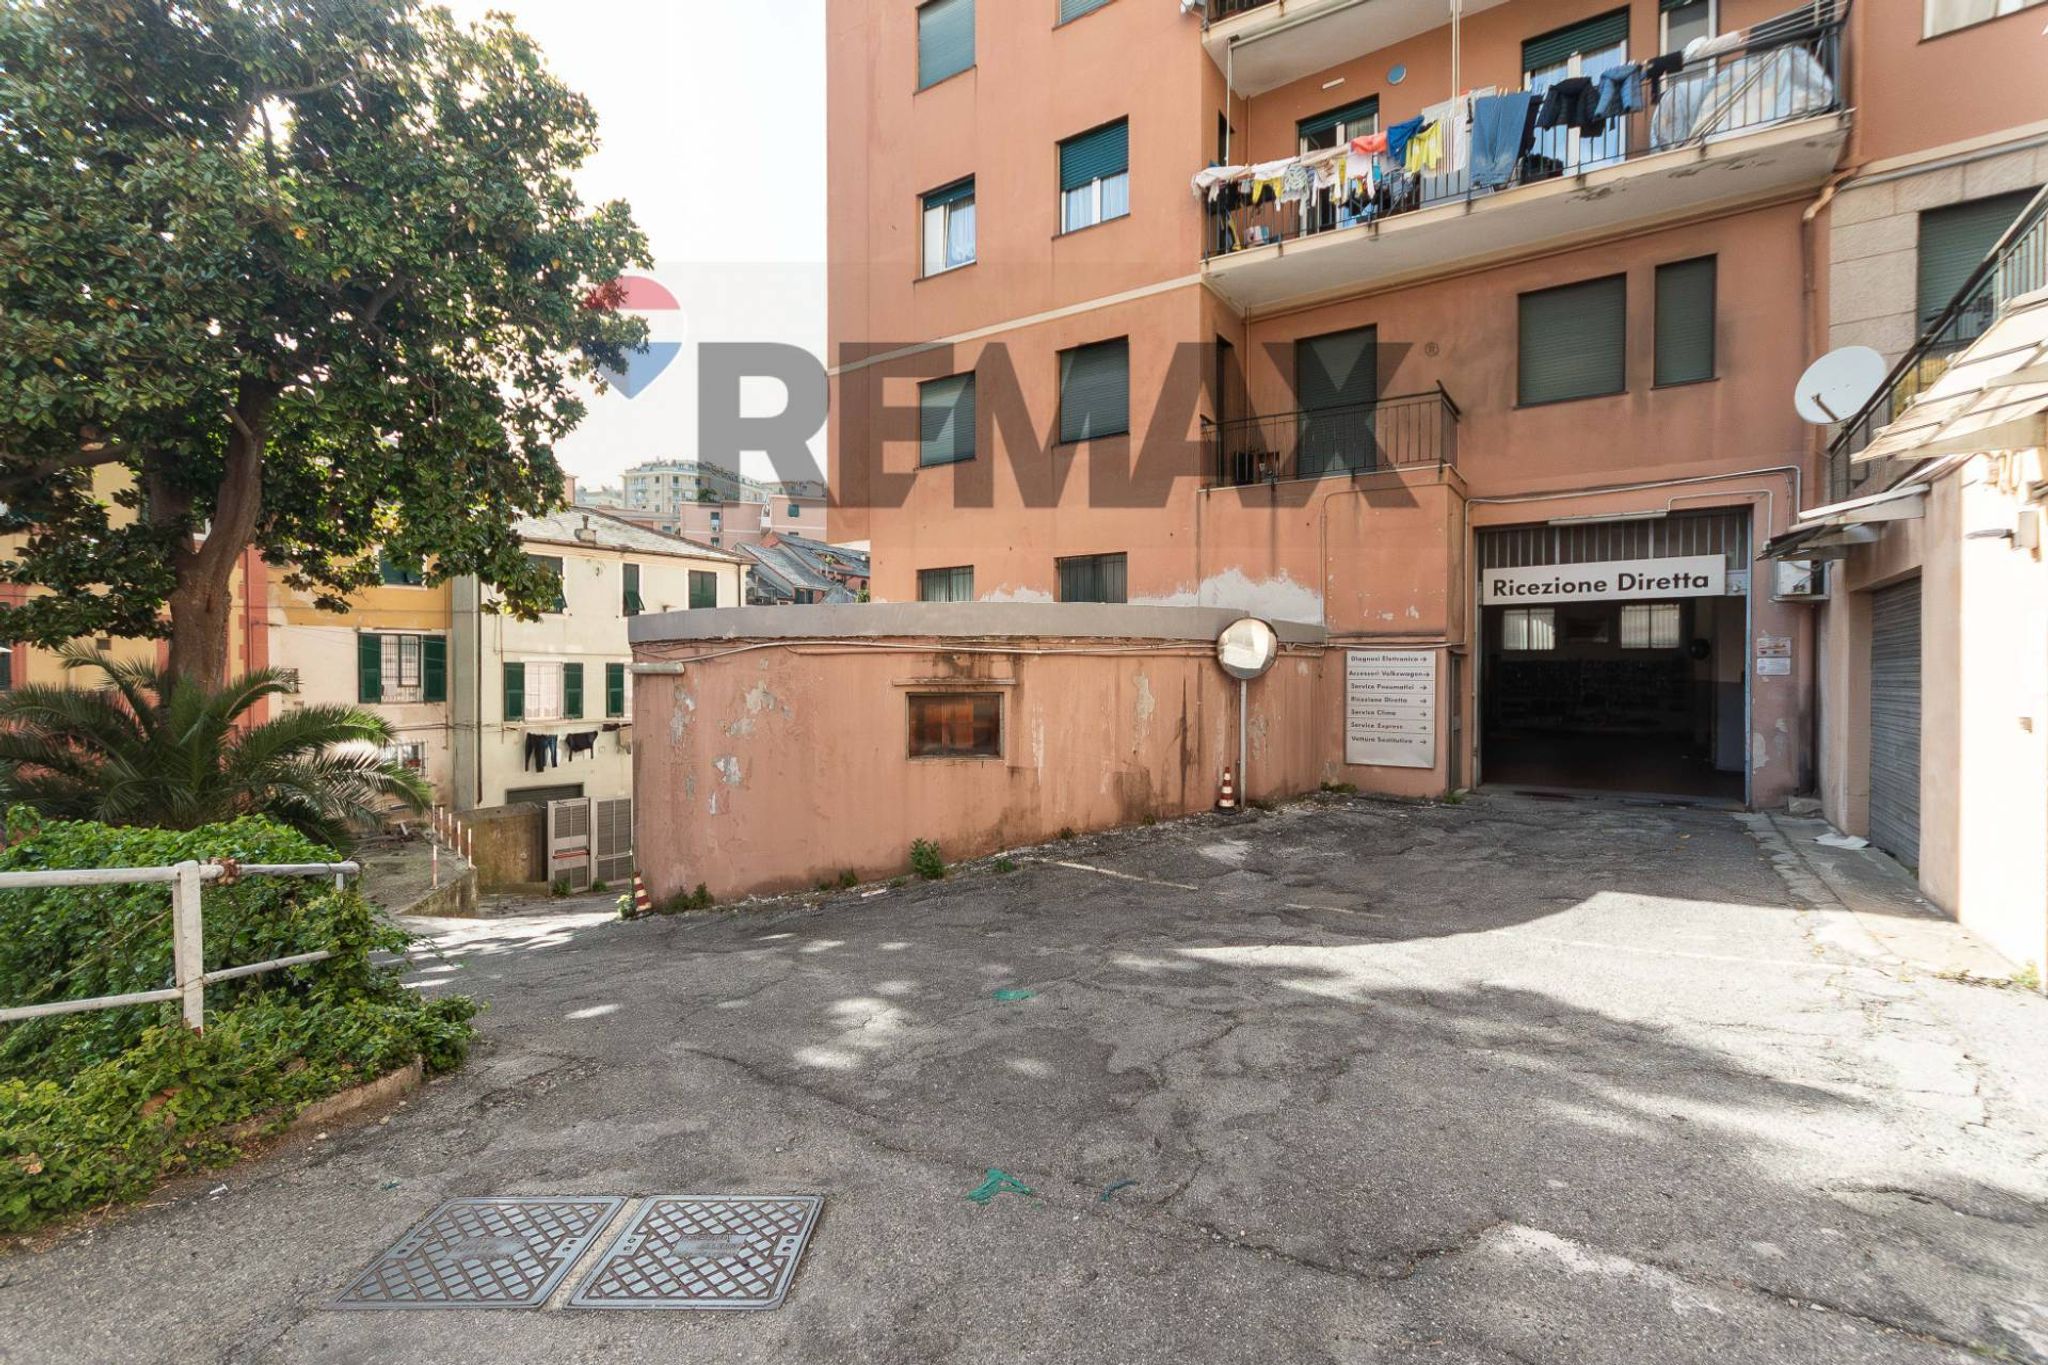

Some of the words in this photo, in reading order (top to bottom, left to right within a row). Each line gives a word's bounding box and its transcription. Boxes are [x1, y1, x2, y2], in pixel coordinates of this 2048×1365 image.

[1492, 577, 1608, 597] Ricezione
[1617, 572, 1710, 592] Diretta
[1381, 670, 1424, 679] Volkswagen
